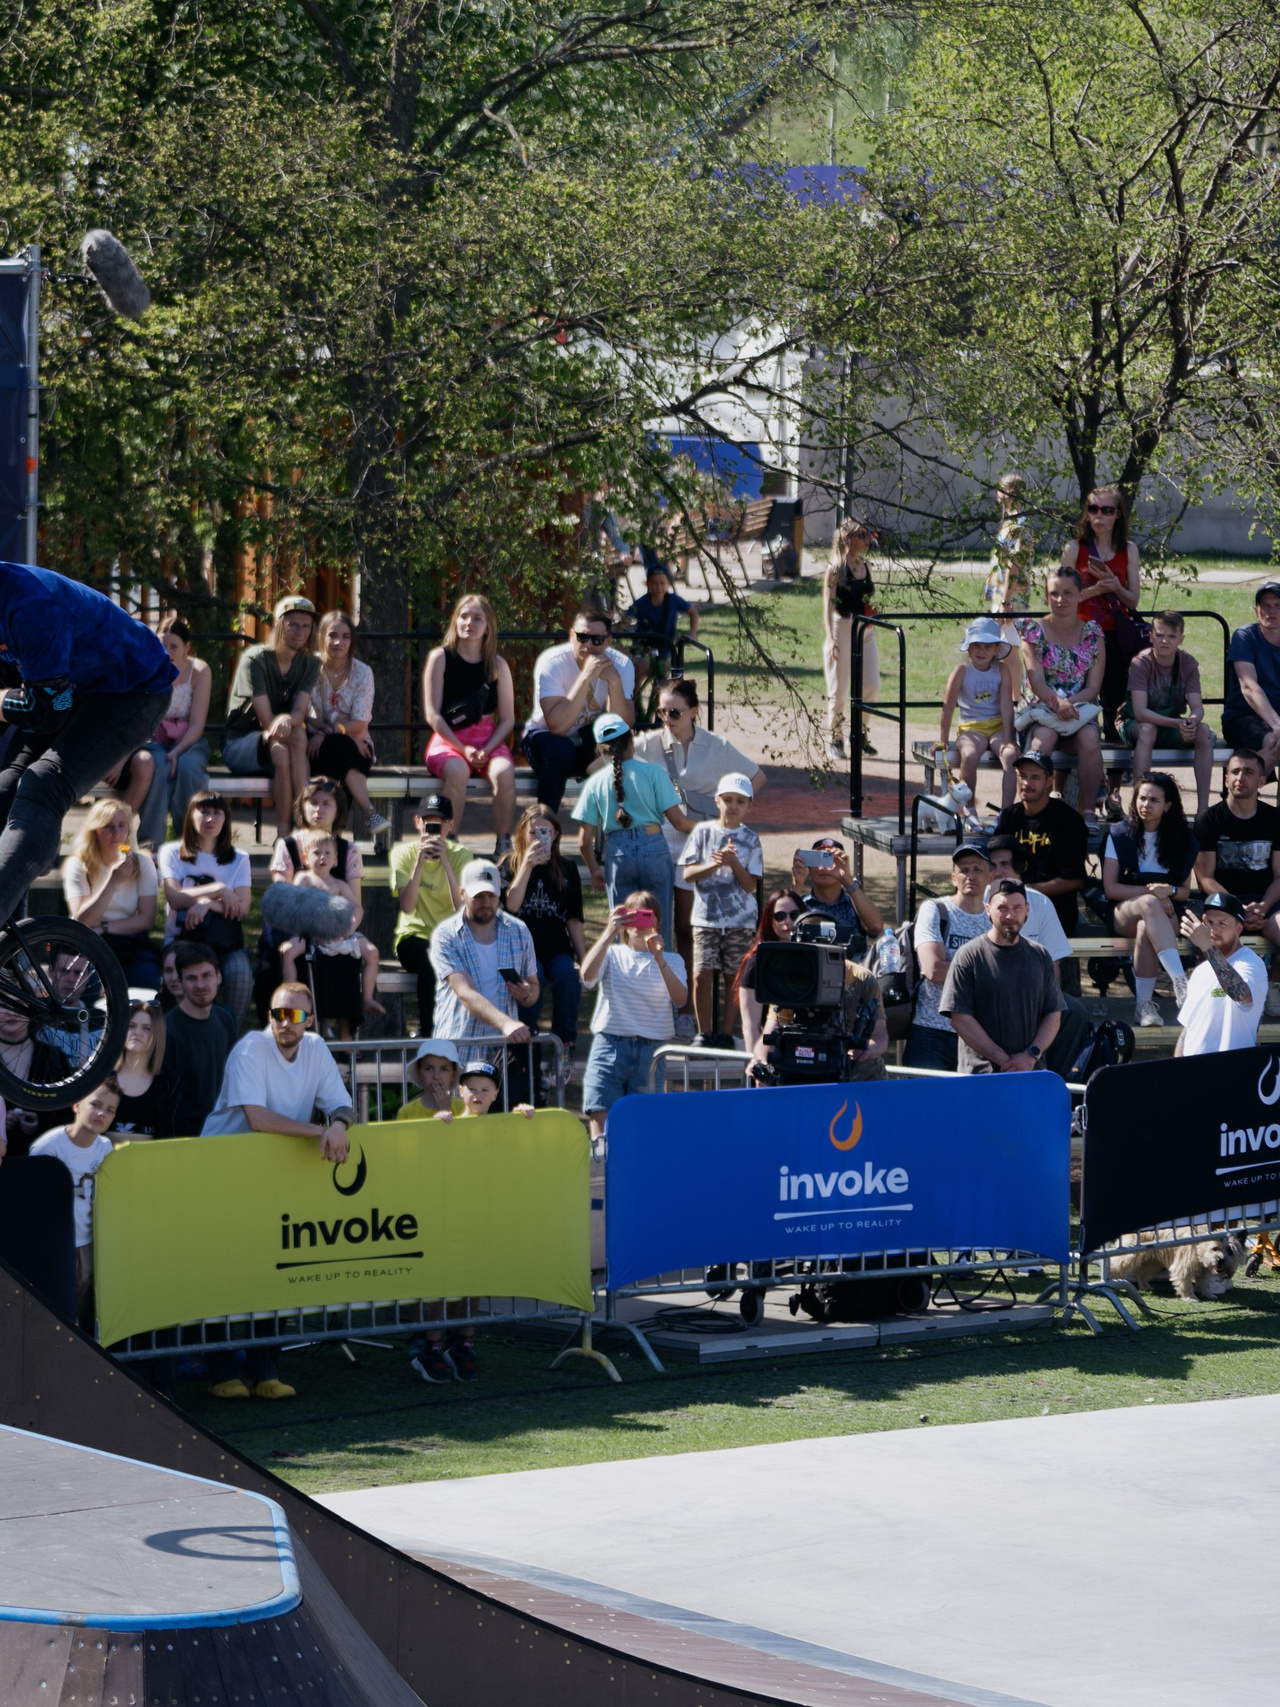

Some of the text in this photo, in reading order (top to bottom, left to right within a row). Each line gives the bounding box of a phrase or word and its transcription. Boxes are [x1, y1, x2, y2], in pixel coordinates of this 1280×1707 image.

[780, 1161, 909, 1201] invoke
[1223, 1172, 1277, 1188] WAKE UP TO
[281, 1208, 419, 1250] invoke
[785, 1218, 902, 1234] WAKE UP TO REALITY
[288, 1267, 412, 1284] WAKE UP TO REALITY
